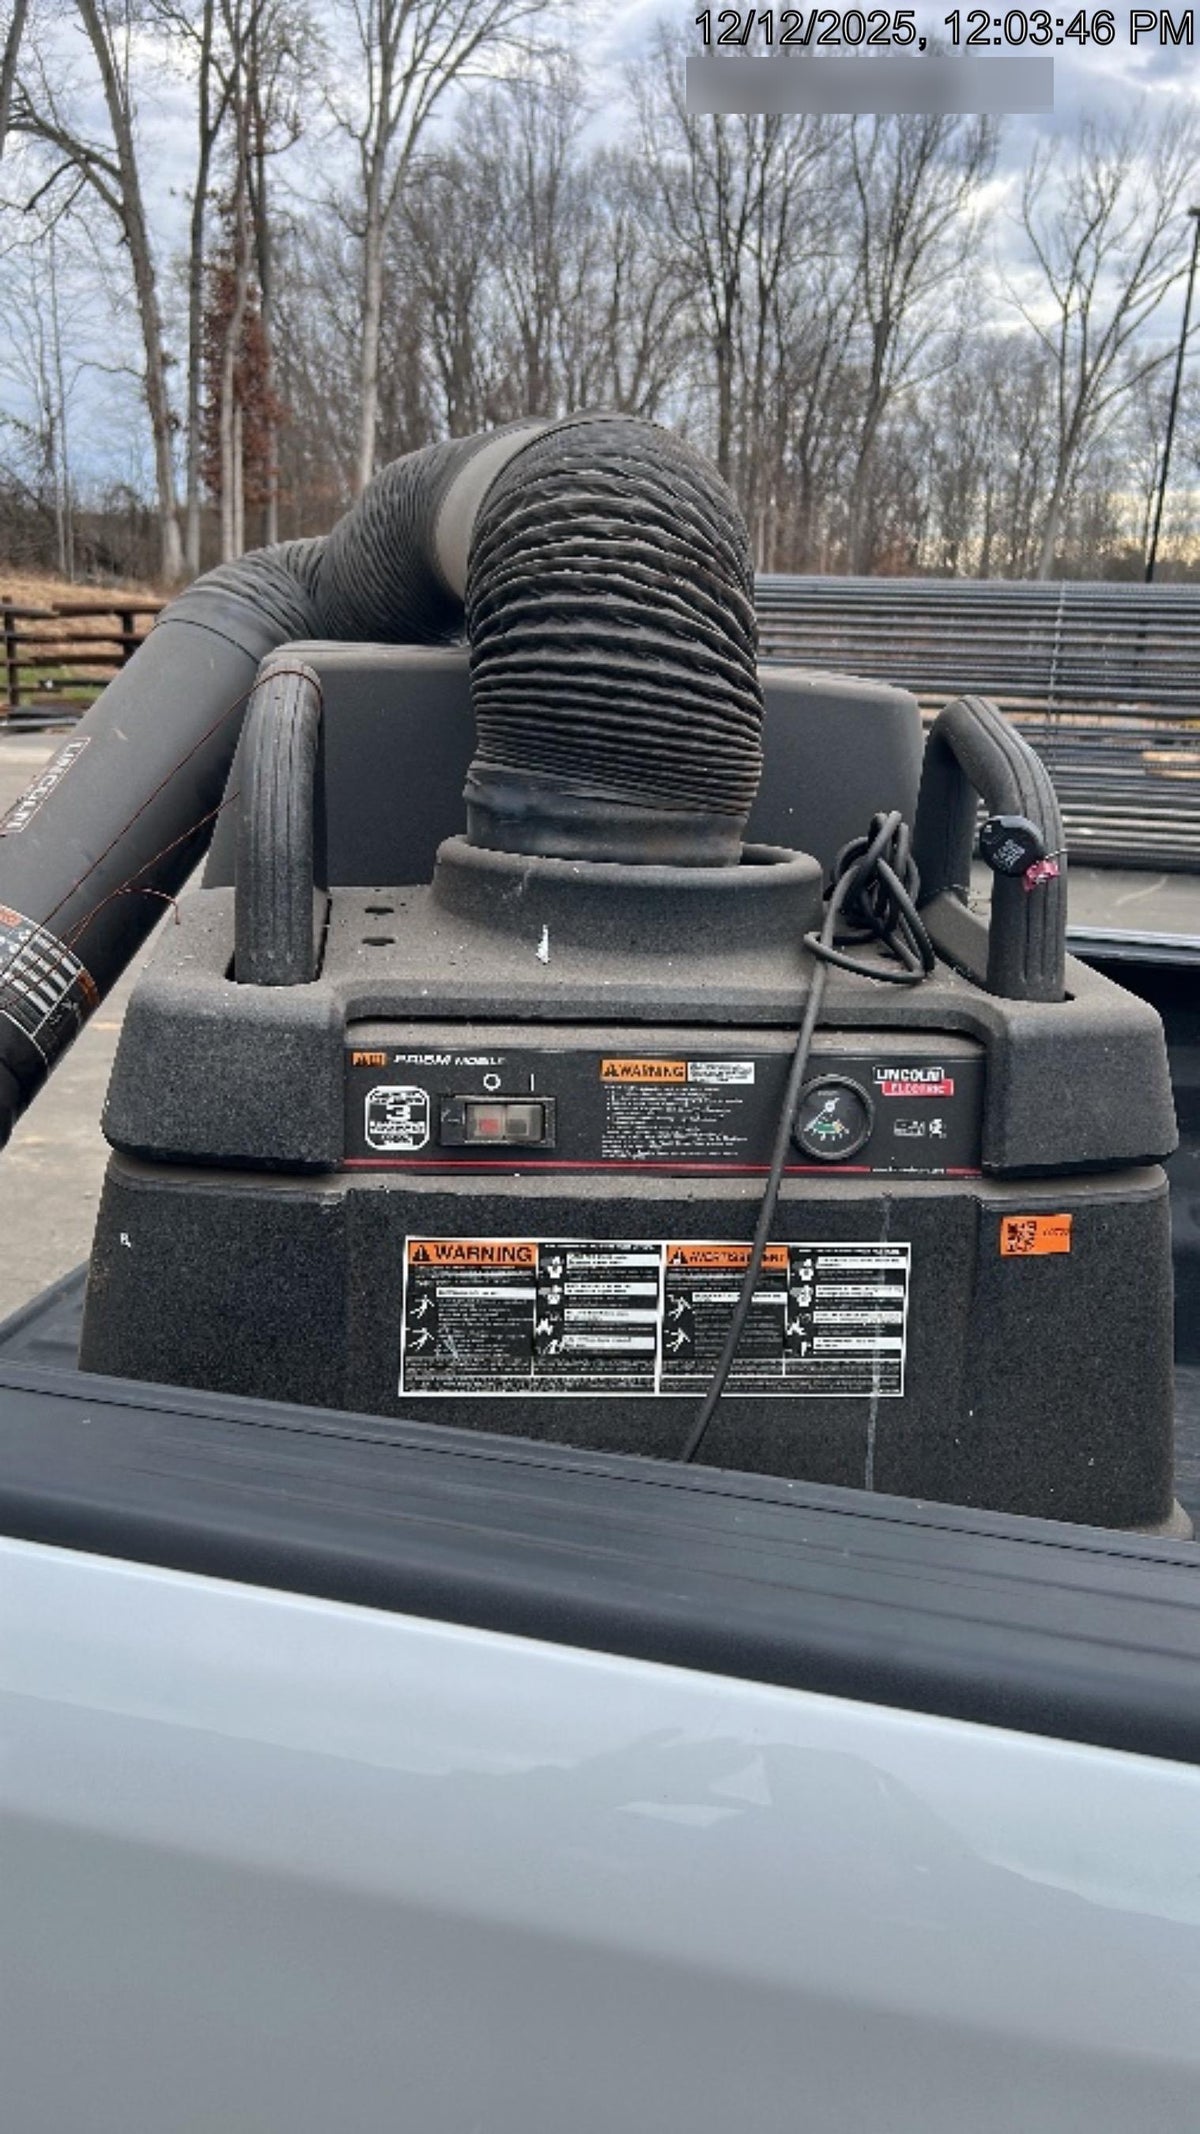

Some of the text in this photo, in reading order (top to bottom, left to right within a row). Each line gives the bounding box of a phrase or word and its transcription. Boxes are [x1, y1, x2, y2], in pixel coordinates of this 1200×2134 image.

[620, 1063, 684, 1078] WARNING
[876, 1068, 940, 1082] LINCOLN
[434, 1244, 533, 1263] WARNING
